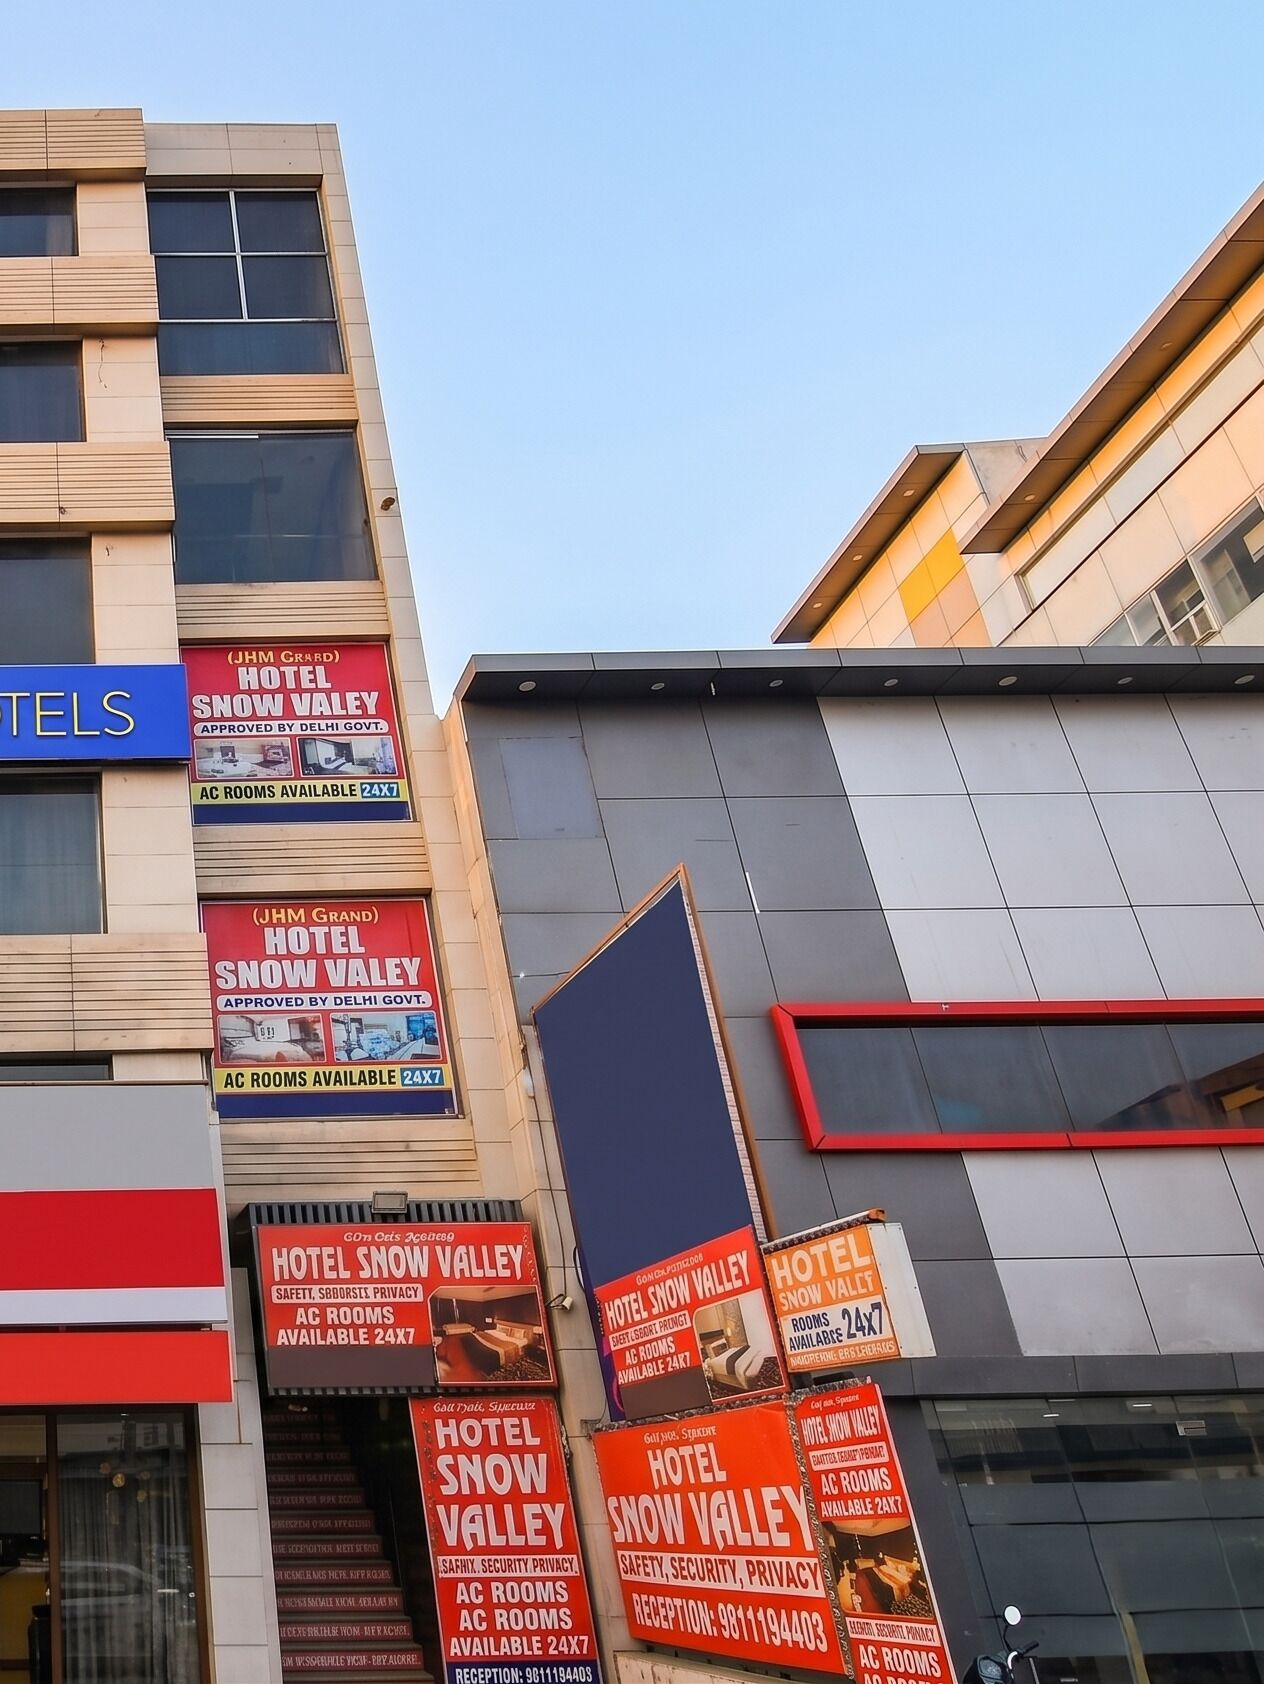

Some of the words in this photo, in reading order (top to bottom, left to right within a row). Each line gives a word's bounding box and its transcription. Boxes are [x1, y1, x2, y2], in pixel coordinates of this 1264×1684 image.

[237, 665, 332, 690] HOTEL
[192, 693, 284, 719] SNOW
[290, 691, 379, 717] VALEY
[200, 723, 273, 734] APPROVED
[277, 723, 295, 733] BY
[300, 722, 339, 732] DELHI
[343, 721, 383, 732] GOVT.
[200, 785, 219, 800] AC
[224, 785, 276, 799] ROOMS
[280, 784, 357, 798] AVAILABLE
[362, 783, 398, 797] 24X7
[264, 926, 366, 955] HOTEL
[215, 959, 317, 989] SNOW
[324, 957, 421, 987] VALEY
[223, 997, 305, 1008] APPROVED
[309, 996, 327, 1007] BY
[333, 995, 378, 1006] DELHI
[382, 994, 426, 1005] GOVT.
[224, 1073, 245, 1088] AC
[250, 1071, 307, 1088] ROOMS
[312, 1069, 397, 1086] AVAILABLE
[403, 1069, 441, 1084] 24X7
[271, 1246, 352, 1281] HOTEL
[356, 1245, 429, 1279] SNOW
[435, 1245, 524, 1280] VALLEY
[771, 1234, 872, 1290] HOTEL
[373, 1286, 419, 1299] PRIVACY
[605, 1291, 648, 1331] HOTEL
[647, 1273, 691, 1315] SNOW
[691, 1250, 750, 1300] VALLEY
[778, 1282, 822, 1311] SNOW
[295, 1307, 321, 1325] AC
[327, 1306, 395, 1325] ROOMS
[791, 1312, 830, 1333] ROOMS
[277, 1328, 369, 1346] AVAILABLE
[374, 1327, 416, 1344] 24X7
[638, 1336, 676, 1362] ROOMS
[618, 1357, 665, 1385] AVAILABLE
[435, 1417, 541, 1450] HOTEL
[800, 1416, 828, 1446] HOTEL
[849, 1405, 881, 1438] VALLEY
[437, 1454, 547, 1495] SNOW
[647, 1442, 727, 1490] HOTEL
[820, 1472, 839, 1495] AC
[839, 1467, 892, 1494] ROOMS
[607, 1493, 685, 1545] SNOW
[687, 1485, 815, 1551] VALLEY
[820, 1498, 874, 1518] AVAILABLE
[437, 1503, 565, 1551] VALLEY
[482, 1558, 529, 1574] SECURITY
[620, 1554, 670, 1582] SAFETY,
[745, 1559, 821, 1591] PRIVACY
[456, 1581, 484, 1604] AC
[491, 1581, 569, 1603] ROOMS
[459, 1608, 487, 1631] AC
[494, 1607, 573, 1631] ROOMS
[632, 1593, 718, 1637] RECEPTION:
[718, 1602, 828, 1653] 9811194403
[450, 1636, 543, 1657] AVAILABLE
[547, 1635, 589, 1655] 24X7
[859, 1644, 880, 1669] AC
[881, 1646, 942, 1678] ROOMS
[455, 1667, 523, 1684] RECEPTION:
